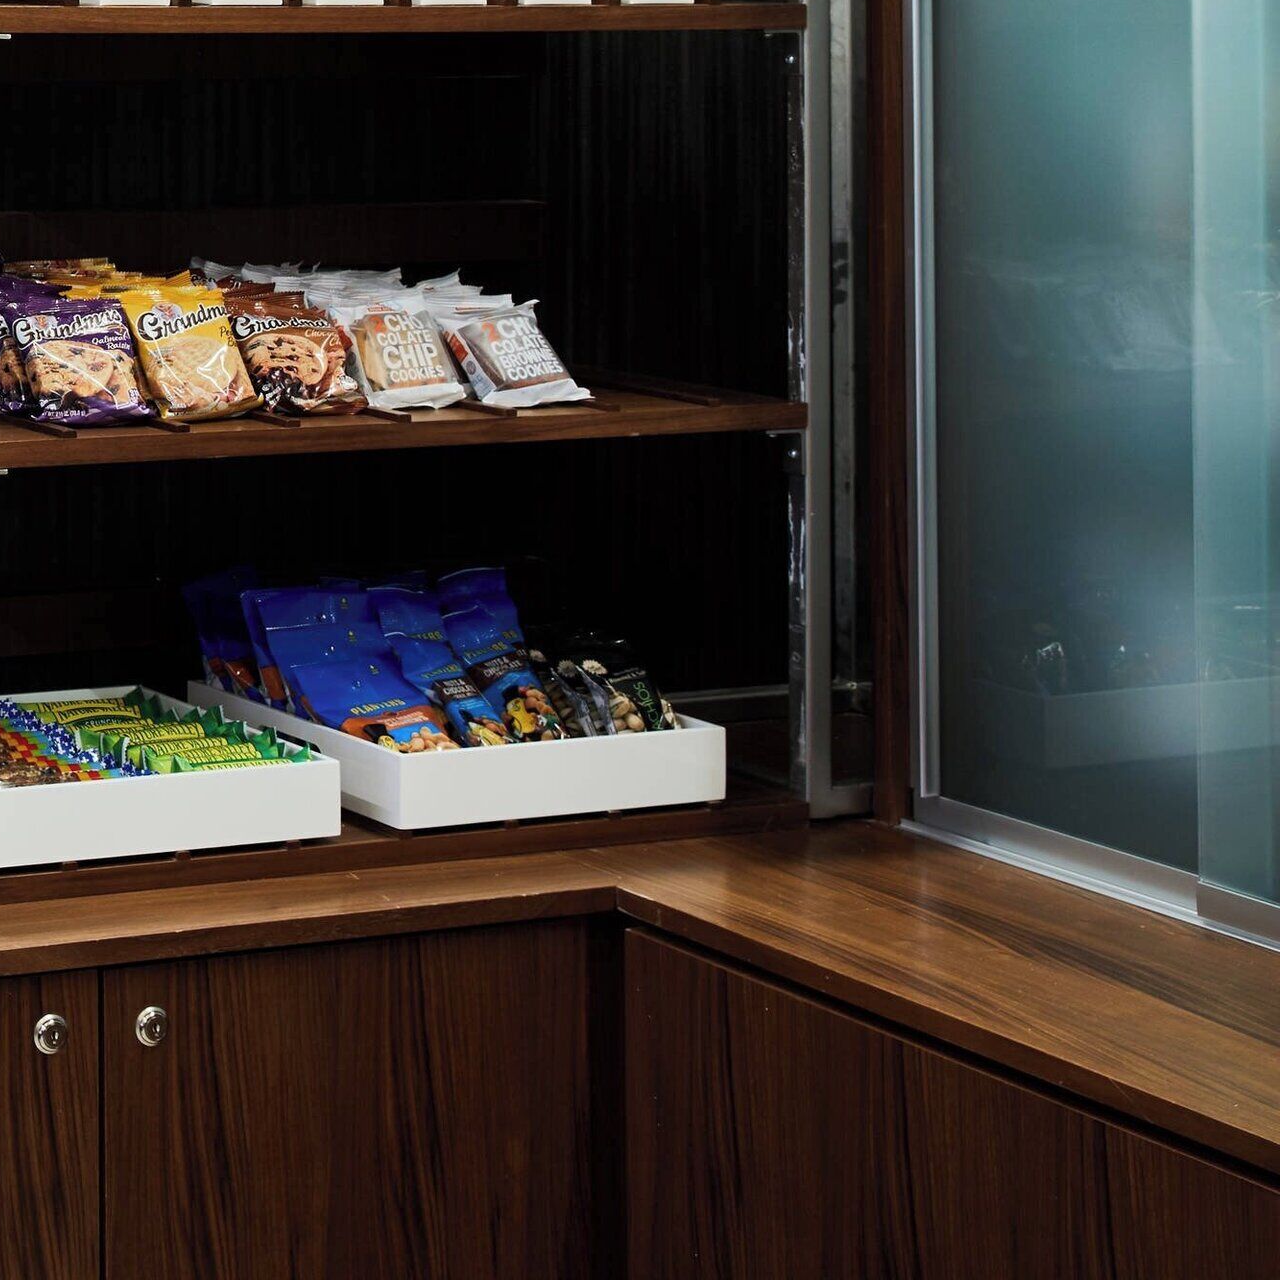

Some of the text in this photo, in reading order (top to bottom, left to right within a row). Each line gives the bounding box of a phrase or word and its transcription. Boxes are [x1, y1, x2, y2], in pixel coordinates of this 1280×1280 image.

[370, 316, 387, 333] 2
[384, 315, 423, 332] CHO
[482, 322, 501, 341] 2
[92, 335, 127, 346] Oatmeal
[106, 341, 131, 351] Raisin
[377, 329, 433, 347] COLATE
[490, 335, 547, 355] COLATE
[382, 344, 438, 369] CHIP
[499, 349, 558, 368] BROWNIE
[390, 365, 445, 383] COOKIES
[508, 363, 563, 381] COOKIES
[351, 698, 406, 715] PLANTERS
